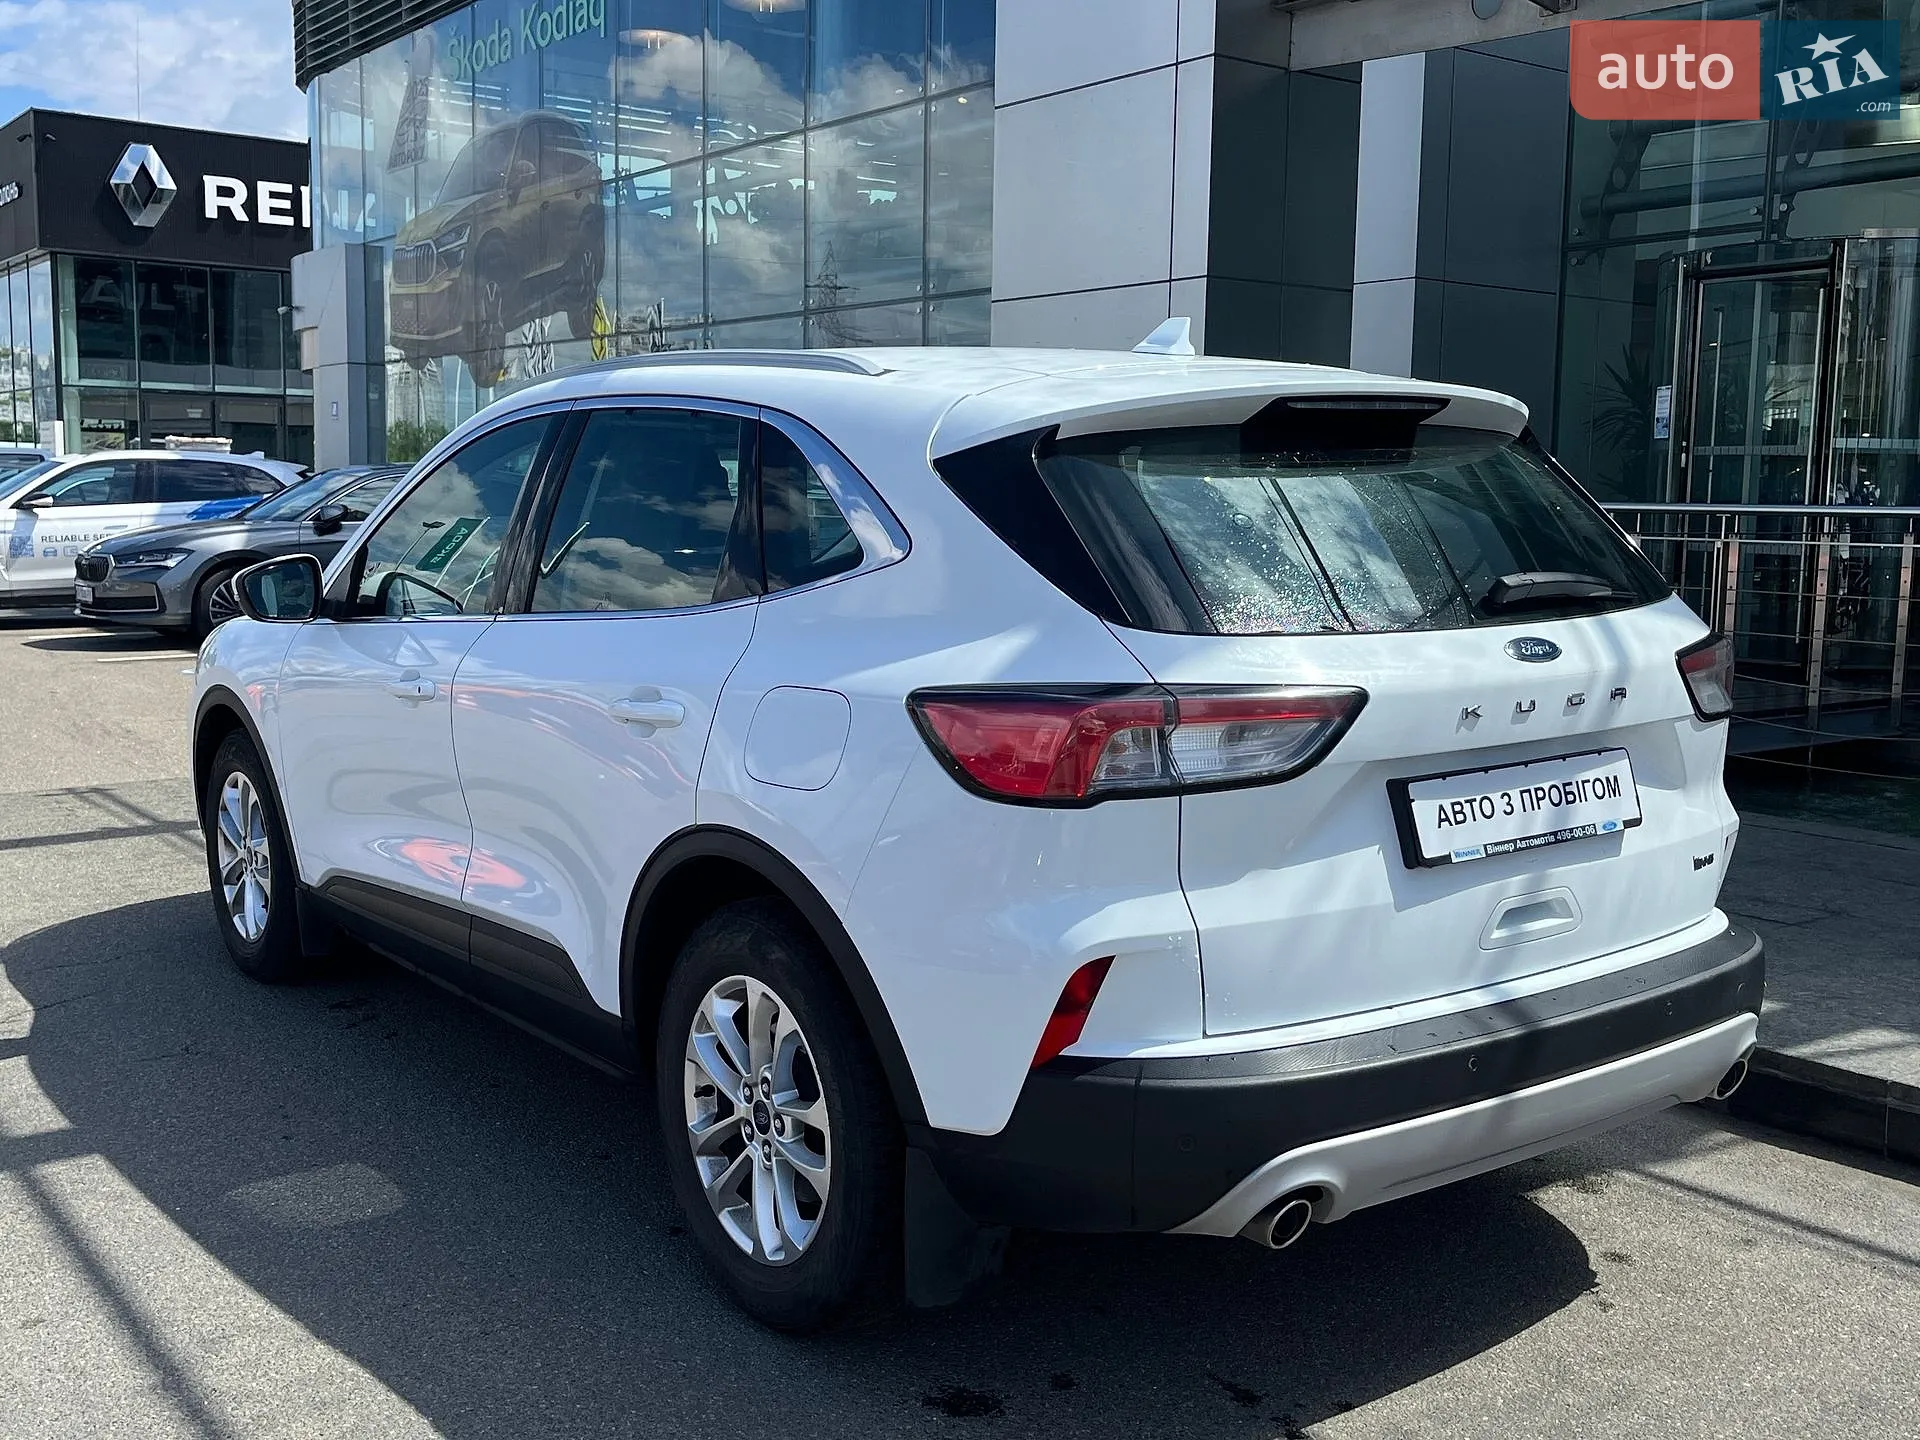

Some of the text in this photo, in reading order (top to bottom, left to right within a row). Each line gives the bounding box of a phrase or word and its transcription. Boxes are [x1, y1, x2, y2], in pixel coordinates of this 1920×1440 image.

[448, 0, 605, 81] Škoda Kodiaq
[41, 535, 90, 543] RELIABLE
[1520, 640, 1553, 655] Ford
[1462, 687, 1627, 720] KUGA
[1437, 795, 1495, 829] АВТО
[1519, 775, 1622, 812] ПРОБІГОМ
[1486, 825, 1595, 854] Віннер Автомотів 496-00-06
